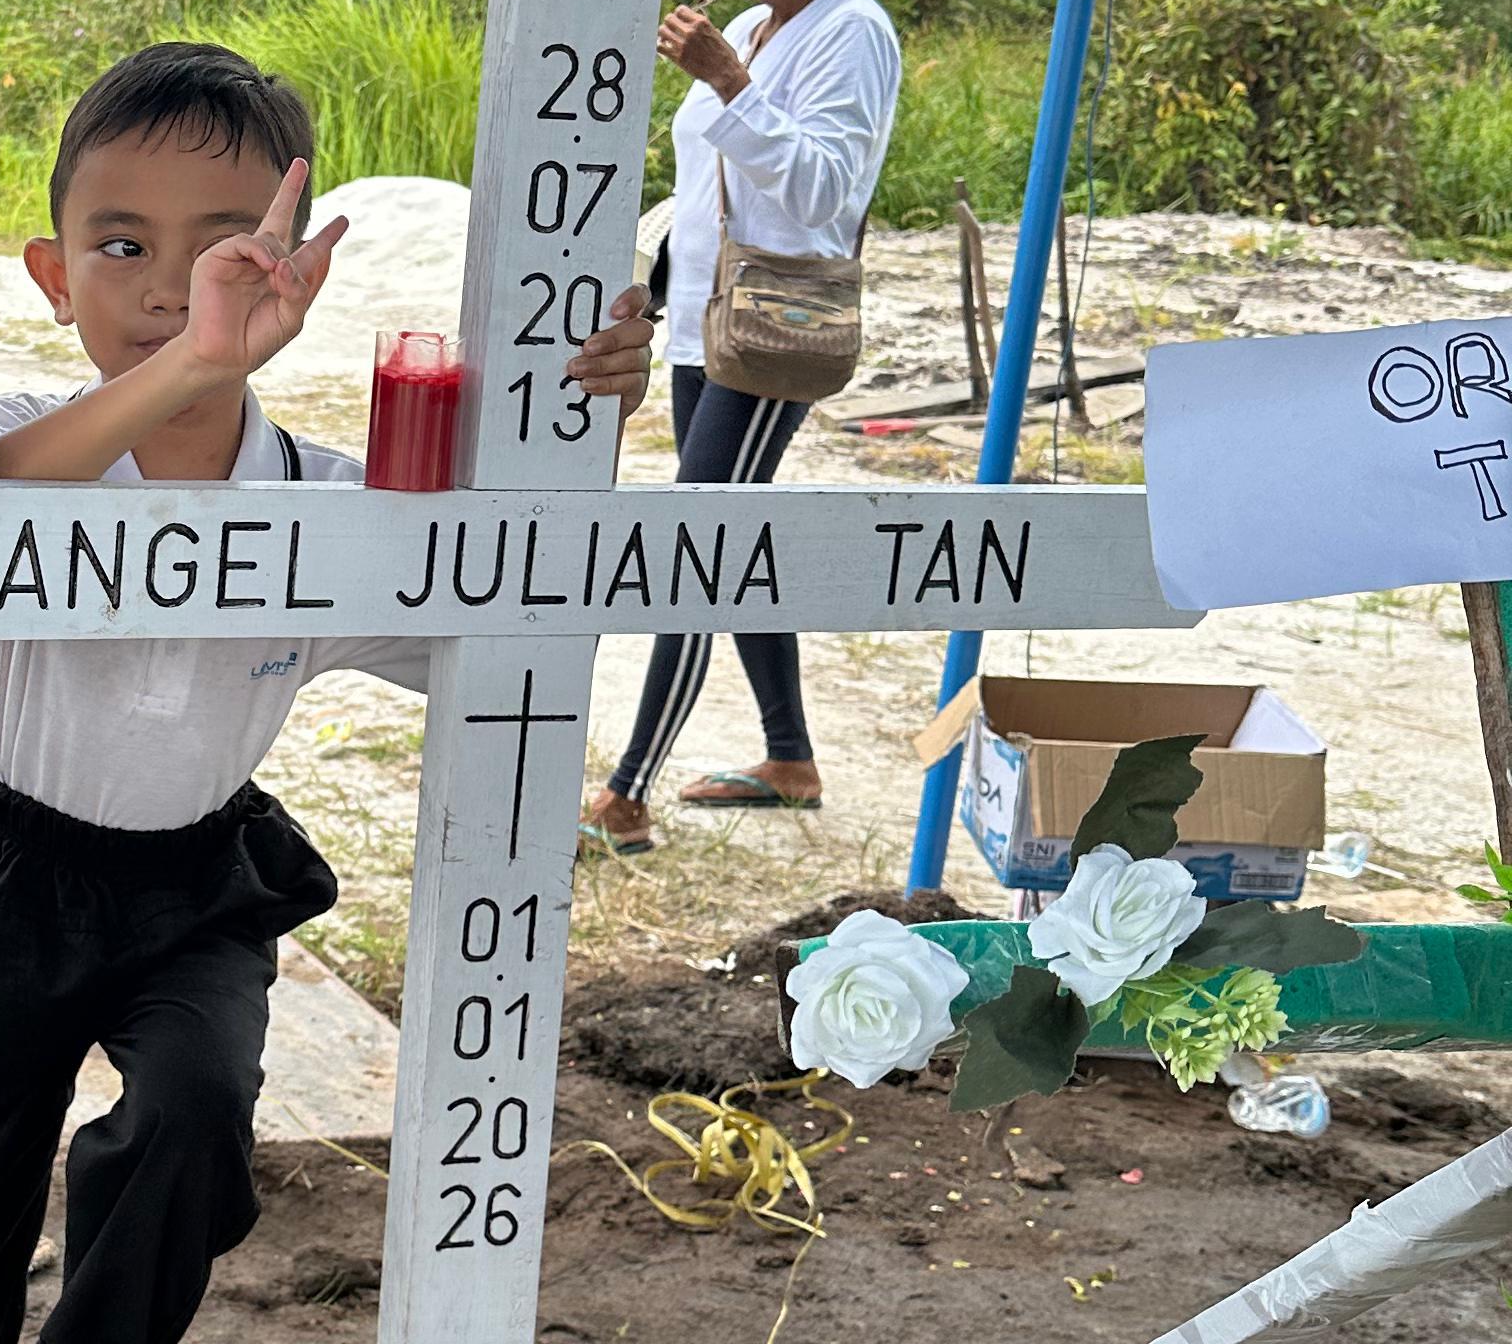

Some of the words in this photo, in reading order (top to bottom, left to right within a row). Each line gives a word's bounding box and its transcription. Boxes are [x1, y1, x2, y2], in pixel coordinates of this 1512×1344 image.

[536, 43, 627, 123] 28
[526, 160, 618, 237] 07
[513, 272, 604, 347] 20
[507, 371, 592, 443] 13
[395, 519, 780, 608] JULIANA
[874, 519, 1031, 606] TAN
[461, 894, 539, 963] 01
[453, 992, 530, 1061] 01
[440, 1096, 528, 1166] 20
[435, 1183, 522, 1252] 26
